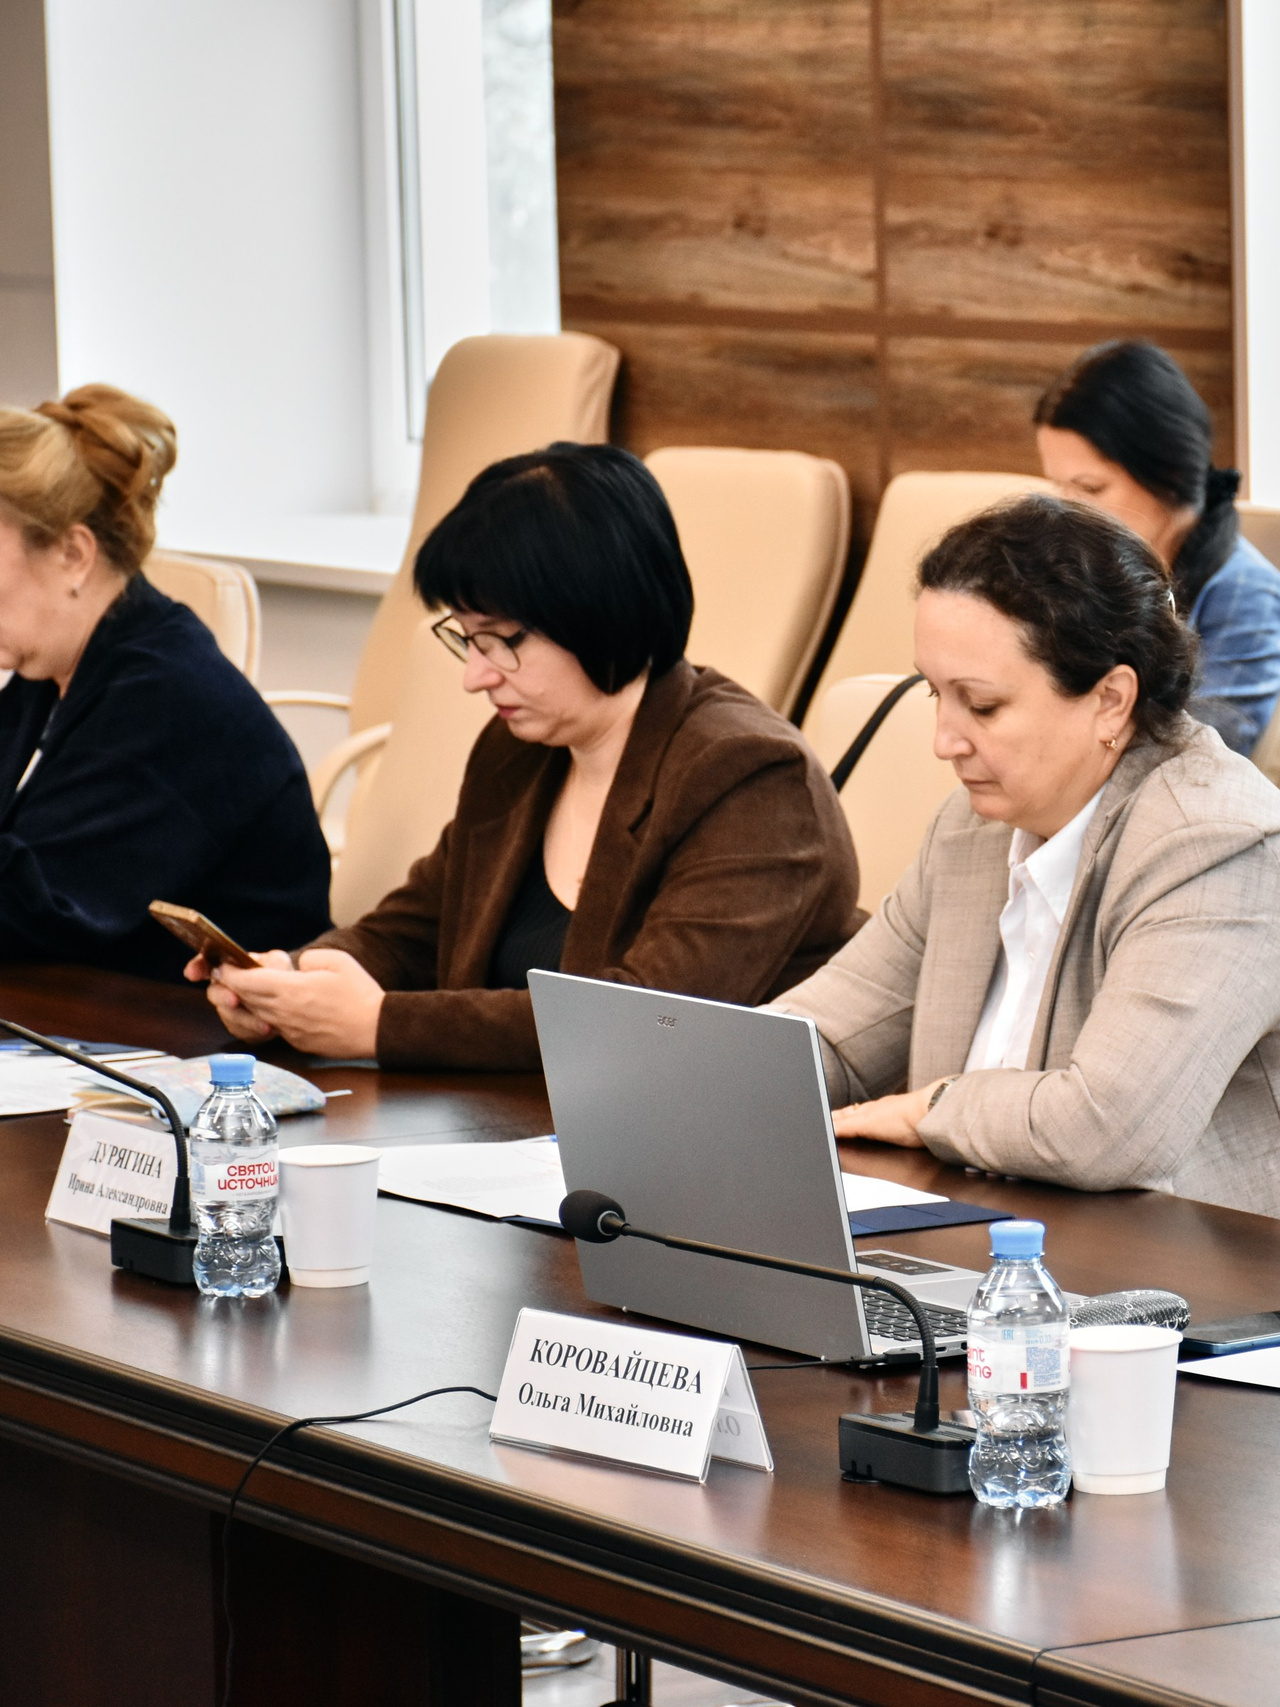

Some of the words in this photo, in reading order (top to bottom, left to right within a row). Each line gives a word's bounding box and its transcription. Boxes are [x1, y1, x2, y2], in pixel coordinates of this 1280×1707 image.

[657, 1015, 677, 1027] acer
[89, 1140, 162, 1179] ДУРЯГИНА
[68, 1172, 95, 1195] Ирина
[96, 1183, 168, 1215] Александровна
[529, 1338, 702, 1394] КОРОВАЙЦЕВА
[518, 1382, 571, 1413] Ольга
[575, 1393, 694, 1437] Михайловна
